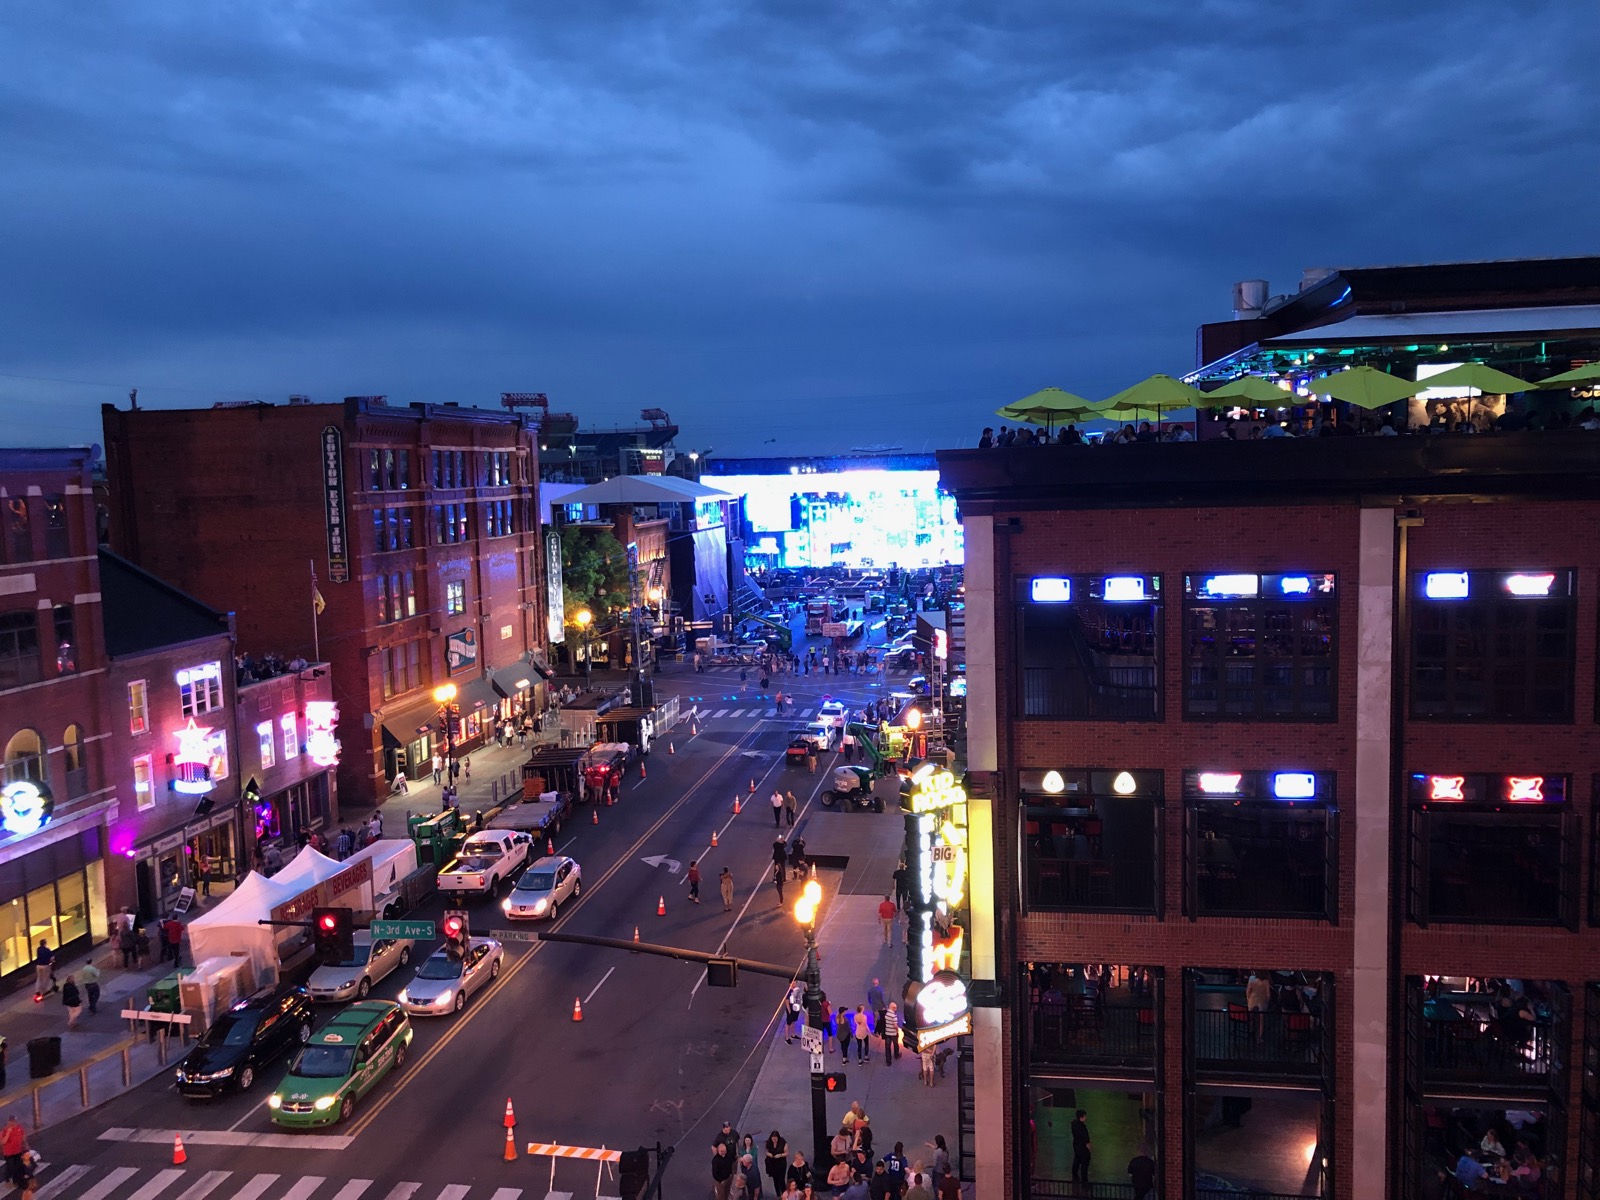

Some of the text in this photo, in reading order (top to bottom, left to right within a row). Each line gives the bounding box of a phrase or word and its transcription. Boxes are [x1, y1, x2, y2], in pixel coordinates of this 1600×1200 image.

[326, 434, 338, 486] COTTON
[329, 489, 340, 525] EYED
[332, 527, 341, 553] JOE
[920, 771, 954, 793] KID
[933, 846, 952, 861] BIG
[332, 862, 368, 896] BEVERAGES
[373, 924, 433, 936] N-3rd Ave-S
[499, 931, 529, 941] PARKING
[802, 1037, 810, 1049] OK
